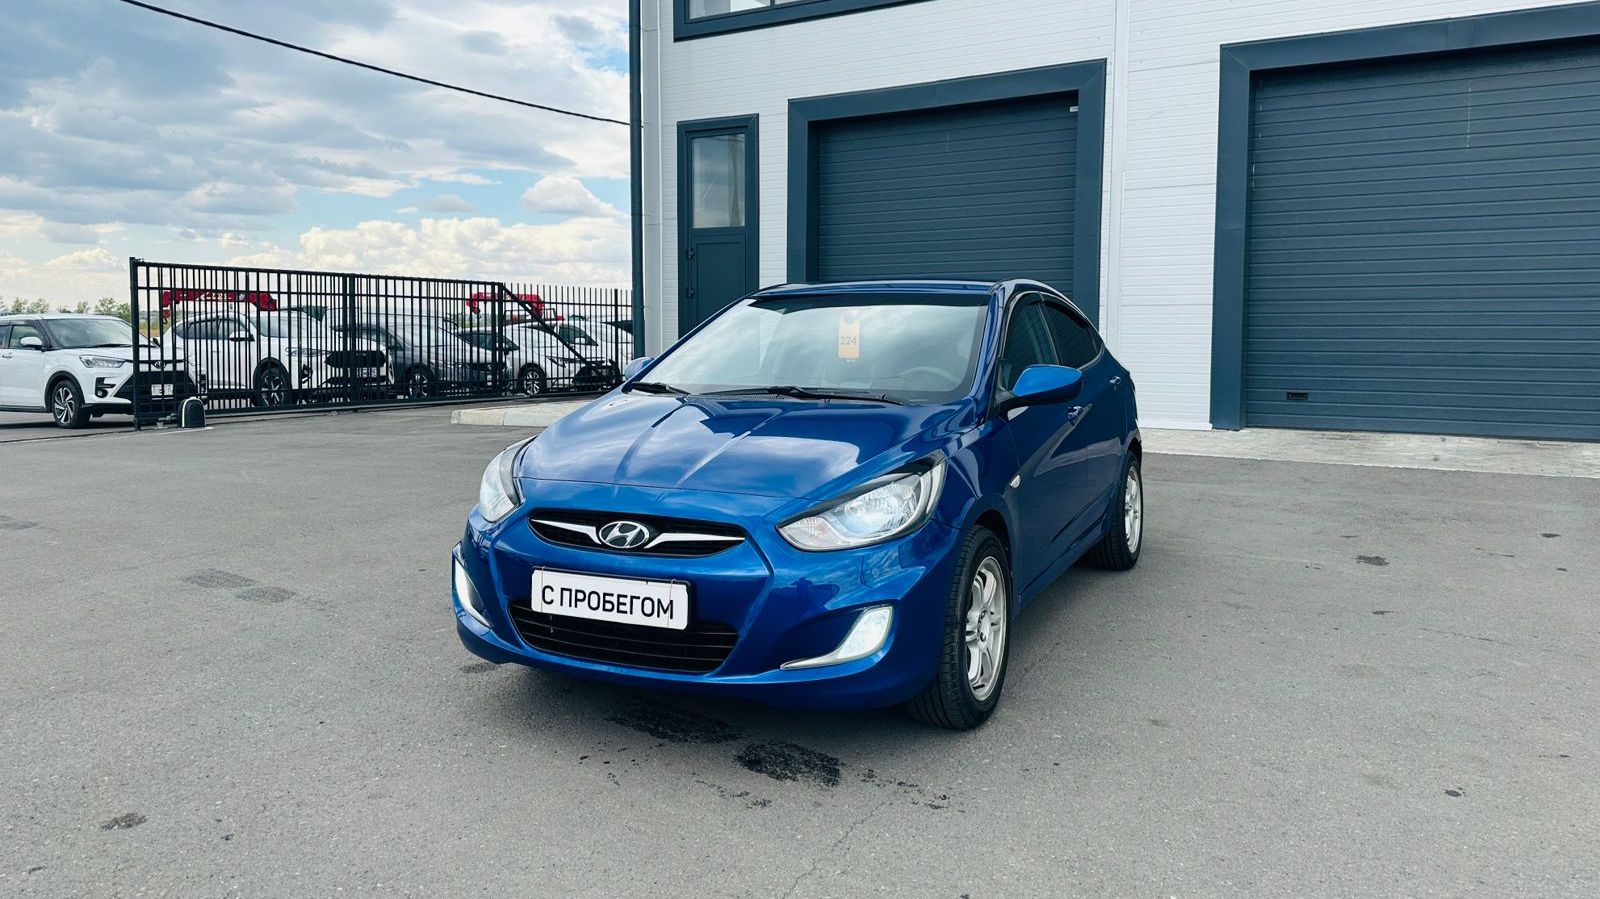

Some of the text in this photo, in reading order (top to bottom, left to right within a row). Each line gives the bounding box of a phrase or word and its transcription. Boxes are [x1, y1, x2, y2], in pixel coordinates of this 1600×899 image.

[840, 335, 857, 345] 224
[542, 585, 674, 620] С ПРОБЕГОМ
